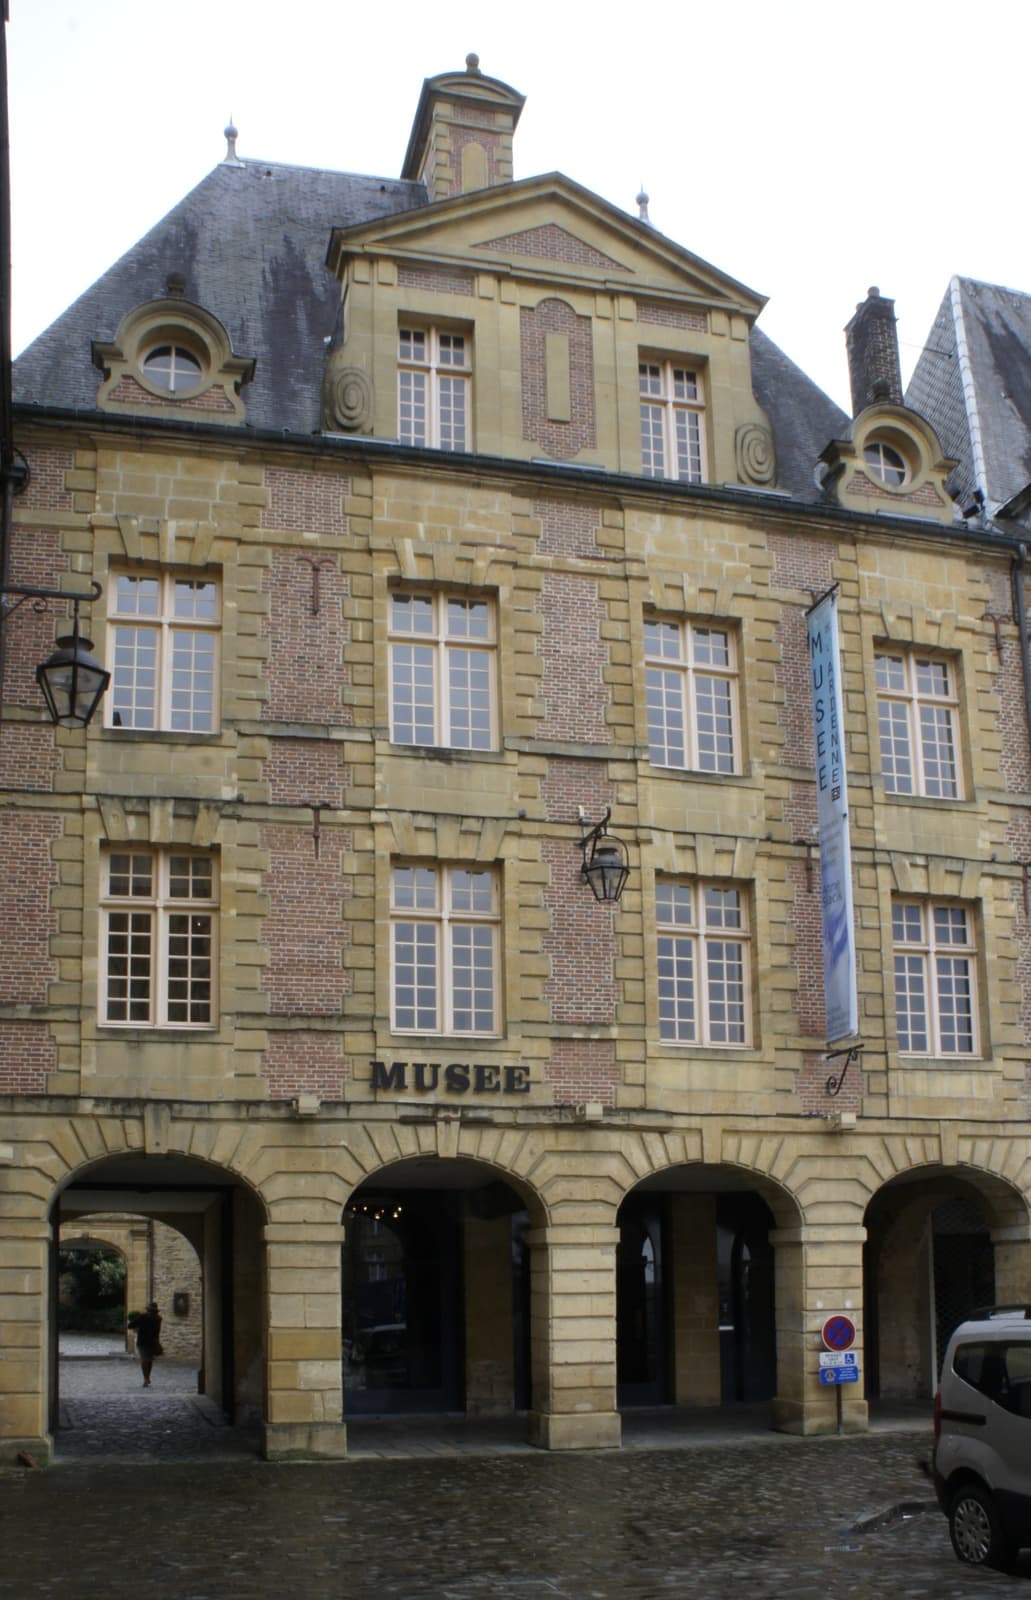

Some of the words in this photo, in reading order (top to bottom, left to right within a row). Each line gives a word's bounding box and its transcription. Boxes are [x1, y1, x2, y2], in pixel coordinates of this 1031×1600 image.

[811, 631, 827, 791] MUSEE
[828, 661, 839, 783] ARDENNE
[369, 1062, 530, 1094] MUSEE
